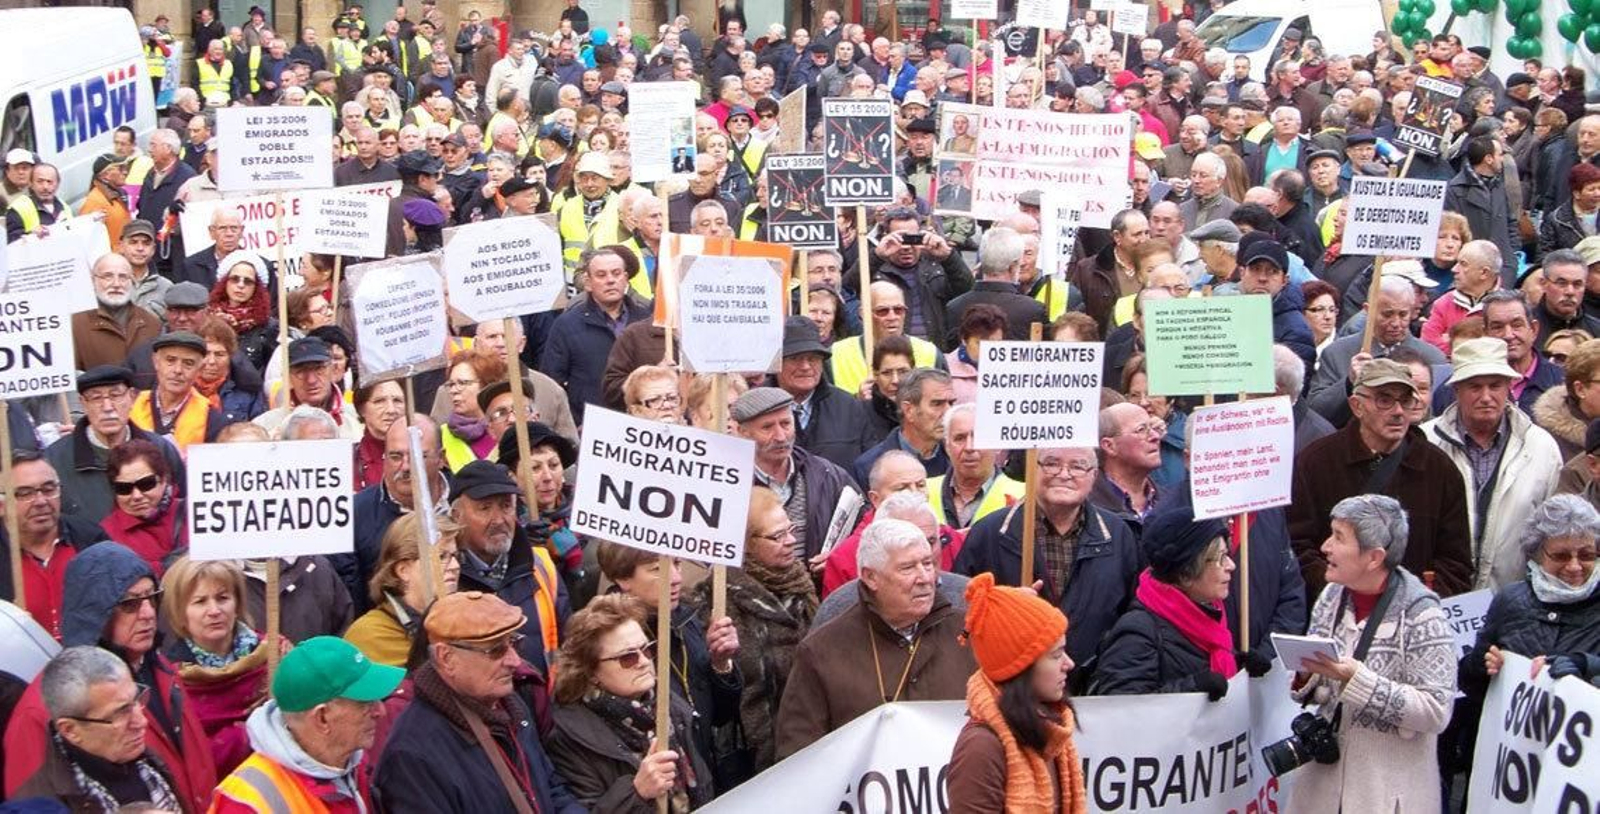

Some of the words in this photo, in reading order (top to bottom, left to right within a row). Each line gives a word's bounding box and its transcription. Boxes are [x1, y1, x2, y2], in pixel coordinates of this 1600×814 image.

[51, 64, 137, 153] MRW
[828, 104, 847, 113] LEY
[246, 116, 263, 125] LEI
[245, 129, 309, 138] EMIGRADOS
[1400, 128, 1437, 151] NON.
[259, 143, 295, 151] DOBLE
[770, 158, 789, 167] LEY
[831, 178, 889, 196] NON.
[1353, 181, 1387, 196] XUSTIZA
[1395, 183, 1443, 199] IGUALDADE
[1354, 207, 1364, 222] DE
[1366, 208, 1406, 223] DEREITOS
[1407, 211, 1429, 225] PARA
[774, 225, 832, 242] NON.
[477, 243, 498, 254] AOS
[501, 238, 531, 250] RICOS
[1356, 234, 1368, 248] OS
[1369, 234, 1421, 251] EMIGRANTES
[470, 258, 490, 269] NIN
[463, 274, 484, 285] AOS
[487, 263, 551, 281] EMIGRANTES
[476, 288, 483, 296] A
[707, 315, 721, 324] QUE
[988, 347, 1006, 361] OS
[1011, 347, 1095, 362] EMIGRANTES
[982, 370, 1098, 388] SACRIFICÁMONOS
[994, 400, 1002, 414] E
[1006, 400, 1016, 414] O
[1020, 400, 1083, 414] GOBERNO
[1205, 413, 1218, 422] der
[1267, 406, 1275, 414] ich
[1195, 427, 1210, 435] eine
[624, 427, 707, 456] SOMOS
[1236, 447, 1253, 456] mein
[592, 440, 740, 485] EMIGRANTES
[1233, 460, 1248, 468] man
[1252, 457, 1267, 465] mich
[1270, 455, 1280, 463] wie
[202, 467, 341, 492] EMIGRANTES
[1213, 471, 1252, 484] Emigrantin
[1254, 469, 1270, 478] ohne
[597, 473, 723, 529] NON
[193, 495, 350, 534] ESTAFADOS
[576, 510, 736, 559] DEFRAUDADORES
